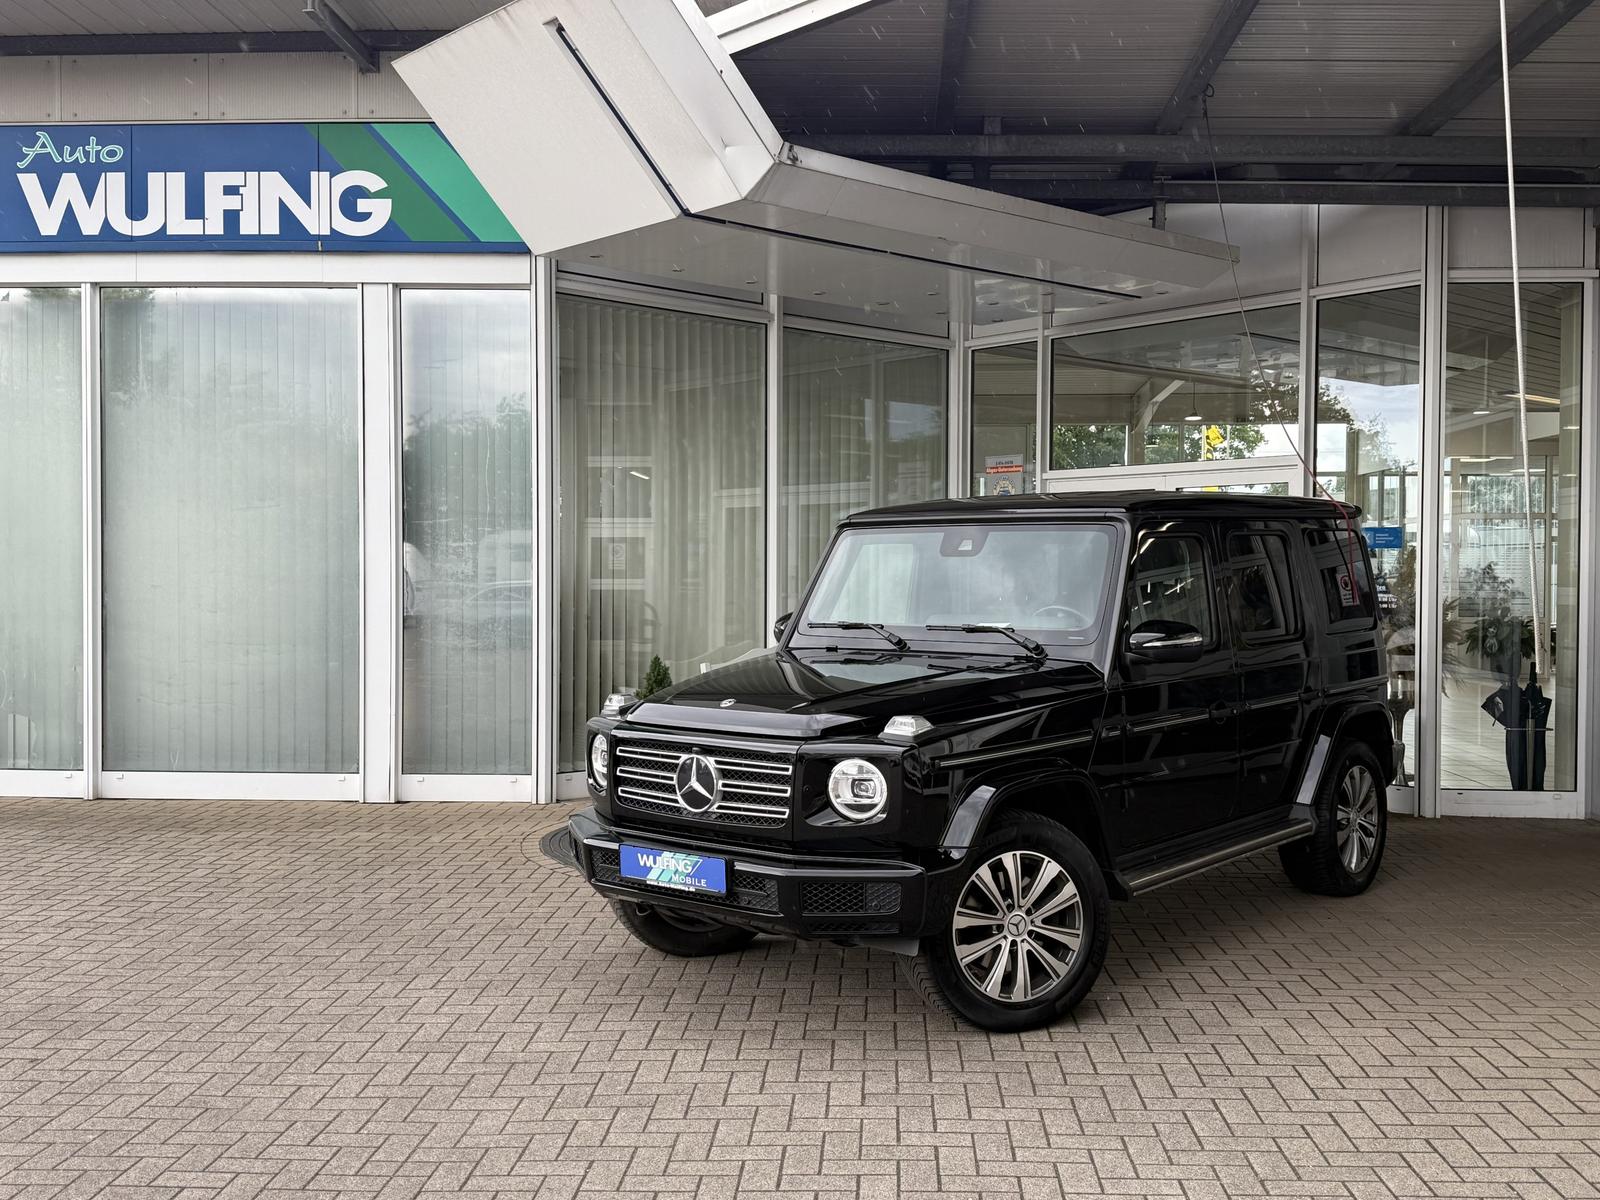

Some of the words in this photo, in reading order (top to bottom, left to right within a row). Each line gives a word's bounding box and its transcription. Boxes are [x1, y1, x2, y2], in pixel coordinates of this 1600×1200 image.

[16, 131, 123, 168] Auto
[16, 169, 393, 237] WULFING
[637, 853, 693, 874] WULFING
[671, 873, 707, 887] MOBILE
